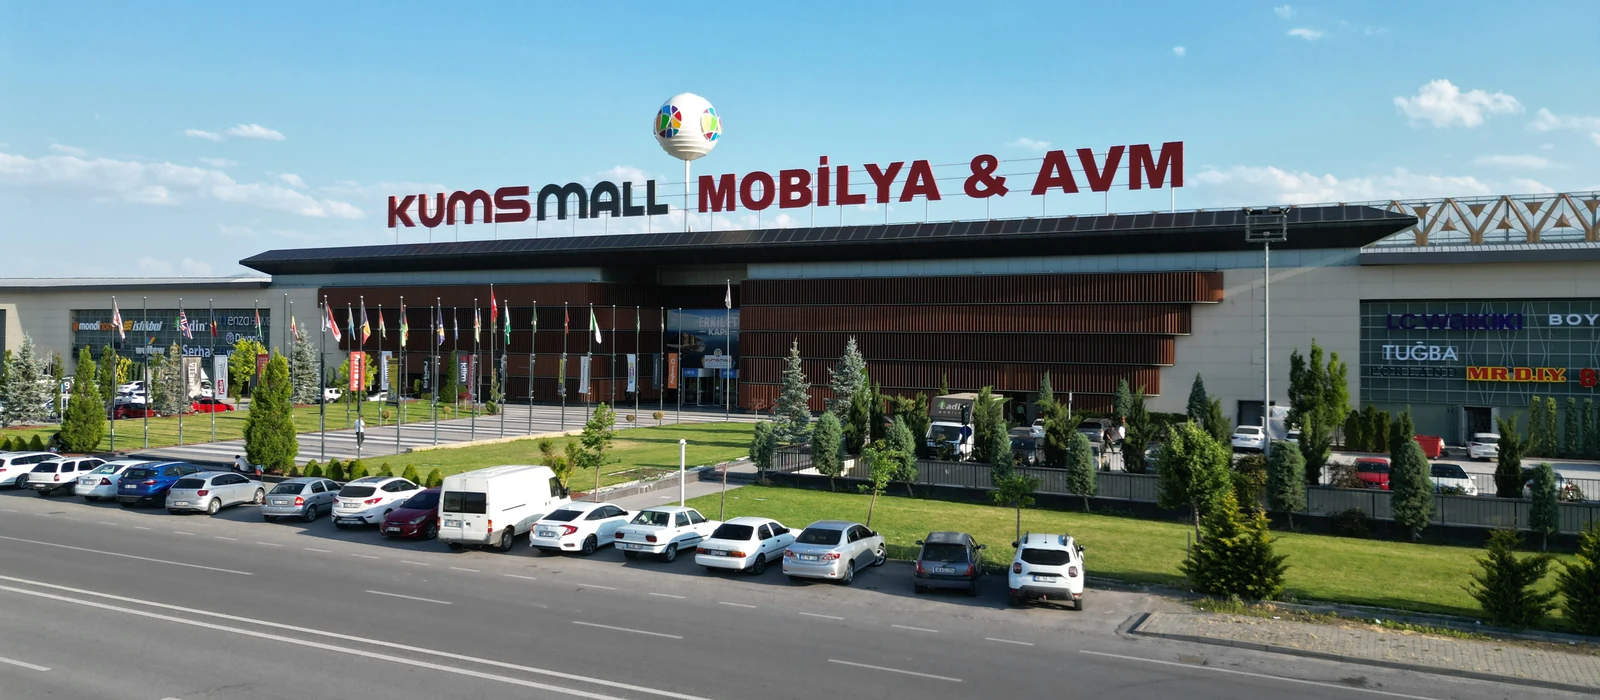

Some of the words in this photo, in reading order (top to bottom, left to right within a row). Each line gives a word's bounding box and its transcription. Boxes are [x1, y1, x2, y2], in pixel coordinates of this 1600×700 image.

[698, 155, 941, 213] MOBİLYA
[963, 154, 1009, 198] &
[1031, 141, 1184, 195] AVM
[176, 319, 205, 332] Ldin
[1387, 313, 1417, 330] LC
[1548, 313, 1600, 326] BOY
[1382, 341, 1458, 361] TUĞBA
[1370, 366, 1457, 378] PORLAND
